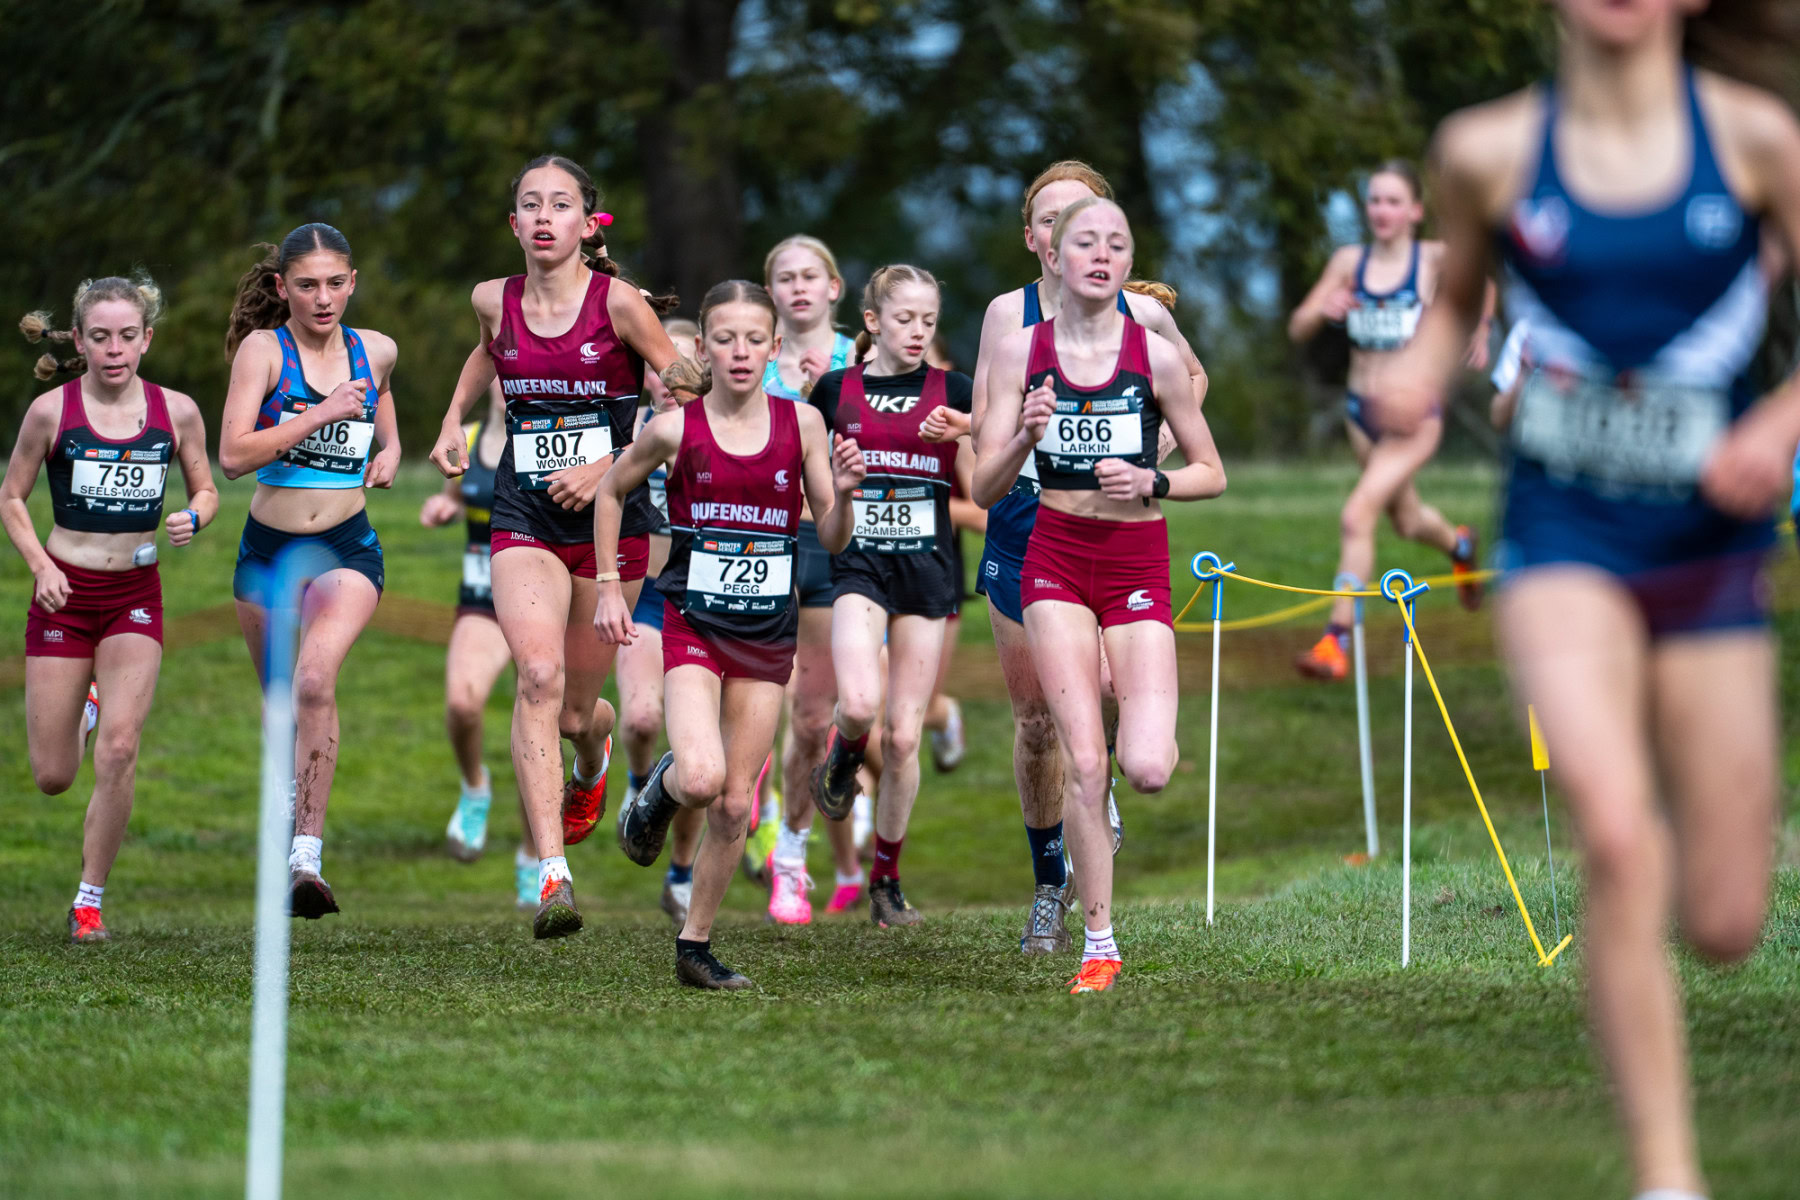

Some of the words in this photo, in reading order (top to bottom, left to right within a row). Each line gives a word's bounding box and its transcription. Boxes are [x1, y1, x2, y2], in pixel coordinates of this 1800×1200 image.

[502, 378, 607, 396] QUEENSLAND
[864, 394, 921, 413] IKE
[306, 422, 350, 445] 06
[1058, 418, 1112, 442] 666
[298, 440, 356, 456] ALAVRIAS
[535, 431, 584, 459] 807
[1060, 443, 1110, 453] LARKIN
[536, 456, 586, 469] WOWOR
[863, 451, 939, 473] EENSLAND
[99, 464, 144, 488] 759
[80, 485, 157, 498] SEELS-WOOD
[690, 502, 788, 528] QUEENSLAND
[865, 504, 911, 526] 548
[856, 525, 921, 536] CHAMBERS
[718, 557, 769, 584] 729
[723, 583, 760, 595] PEGG
